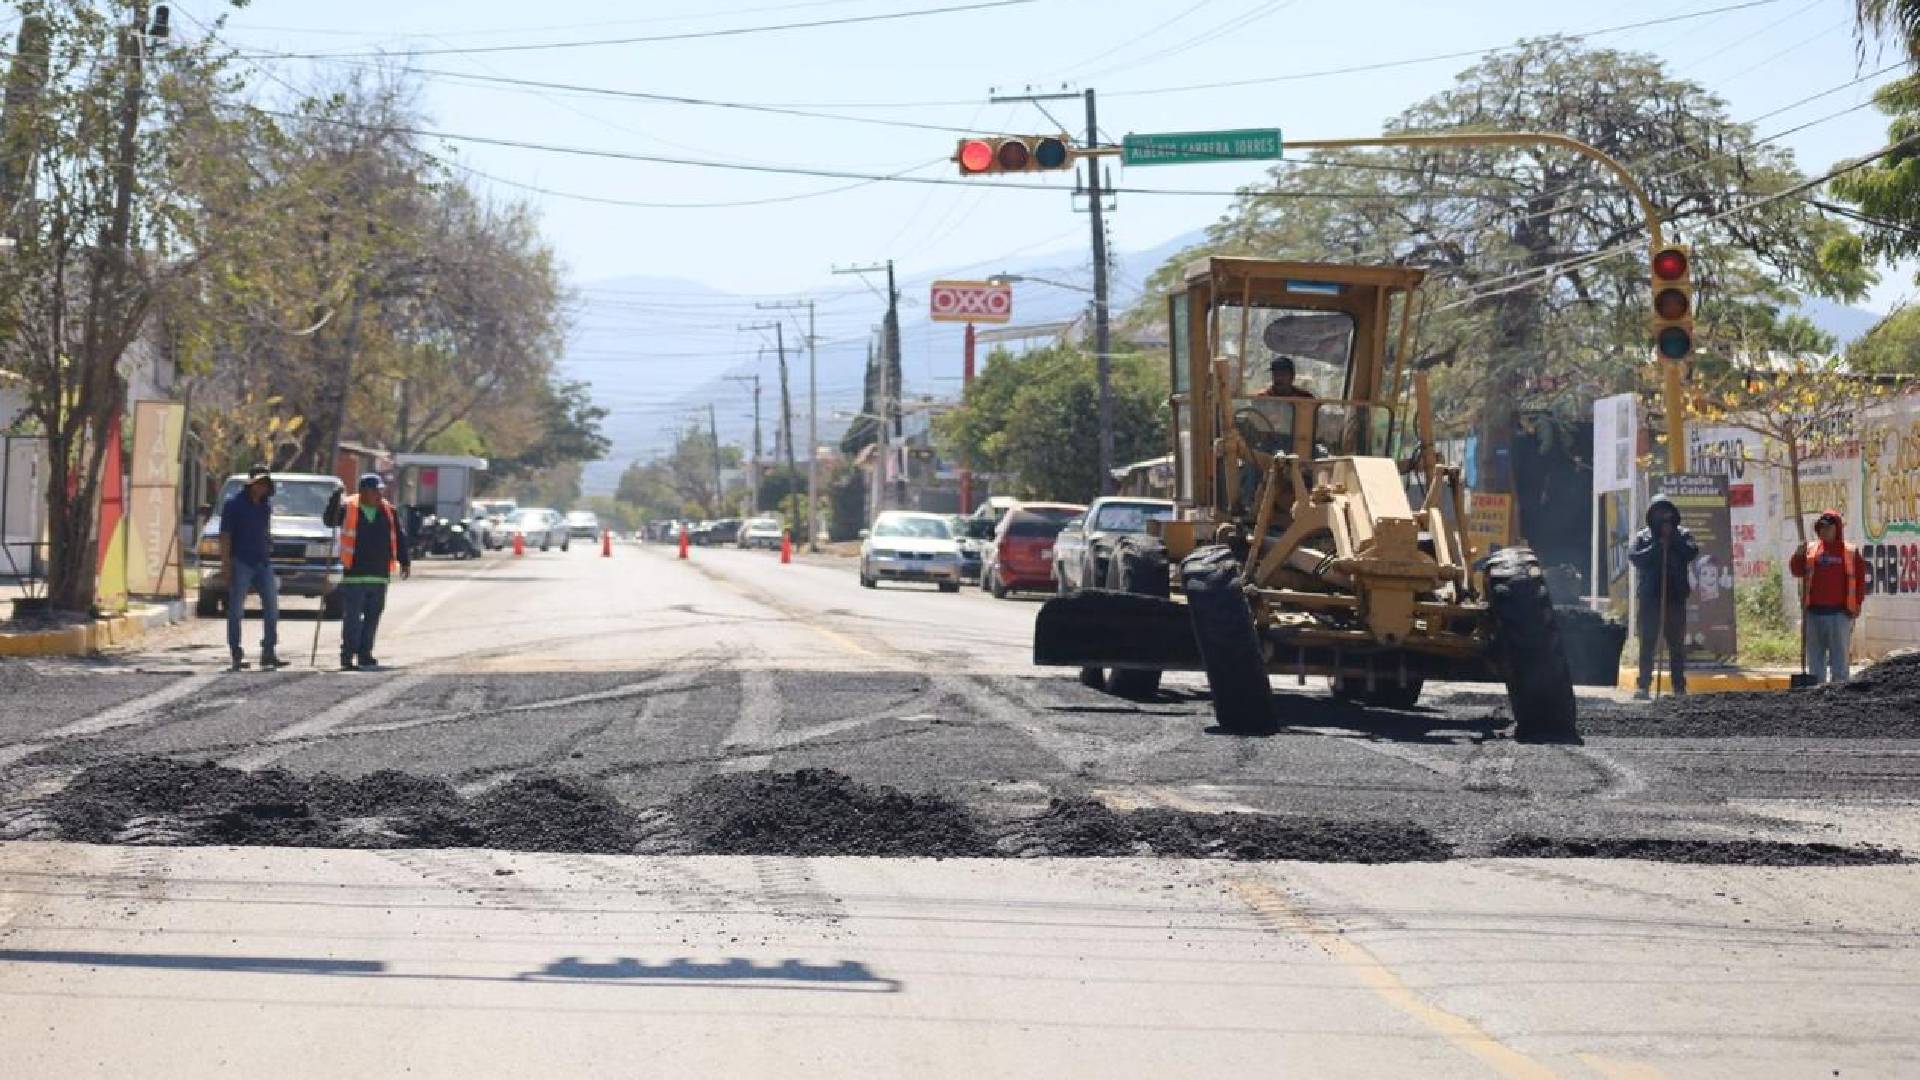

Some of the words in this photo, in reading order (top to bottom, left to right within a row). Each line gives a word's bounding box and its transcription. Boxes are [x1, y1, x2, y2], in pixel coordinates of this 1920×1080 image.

[1132, 145, 1177, 160] ALBERTO
[1184, 142, 1229, 157] CARRERA
[1236, 138, 1275, 154] TORRES
[935, 289, 1008, 313] OXXO
